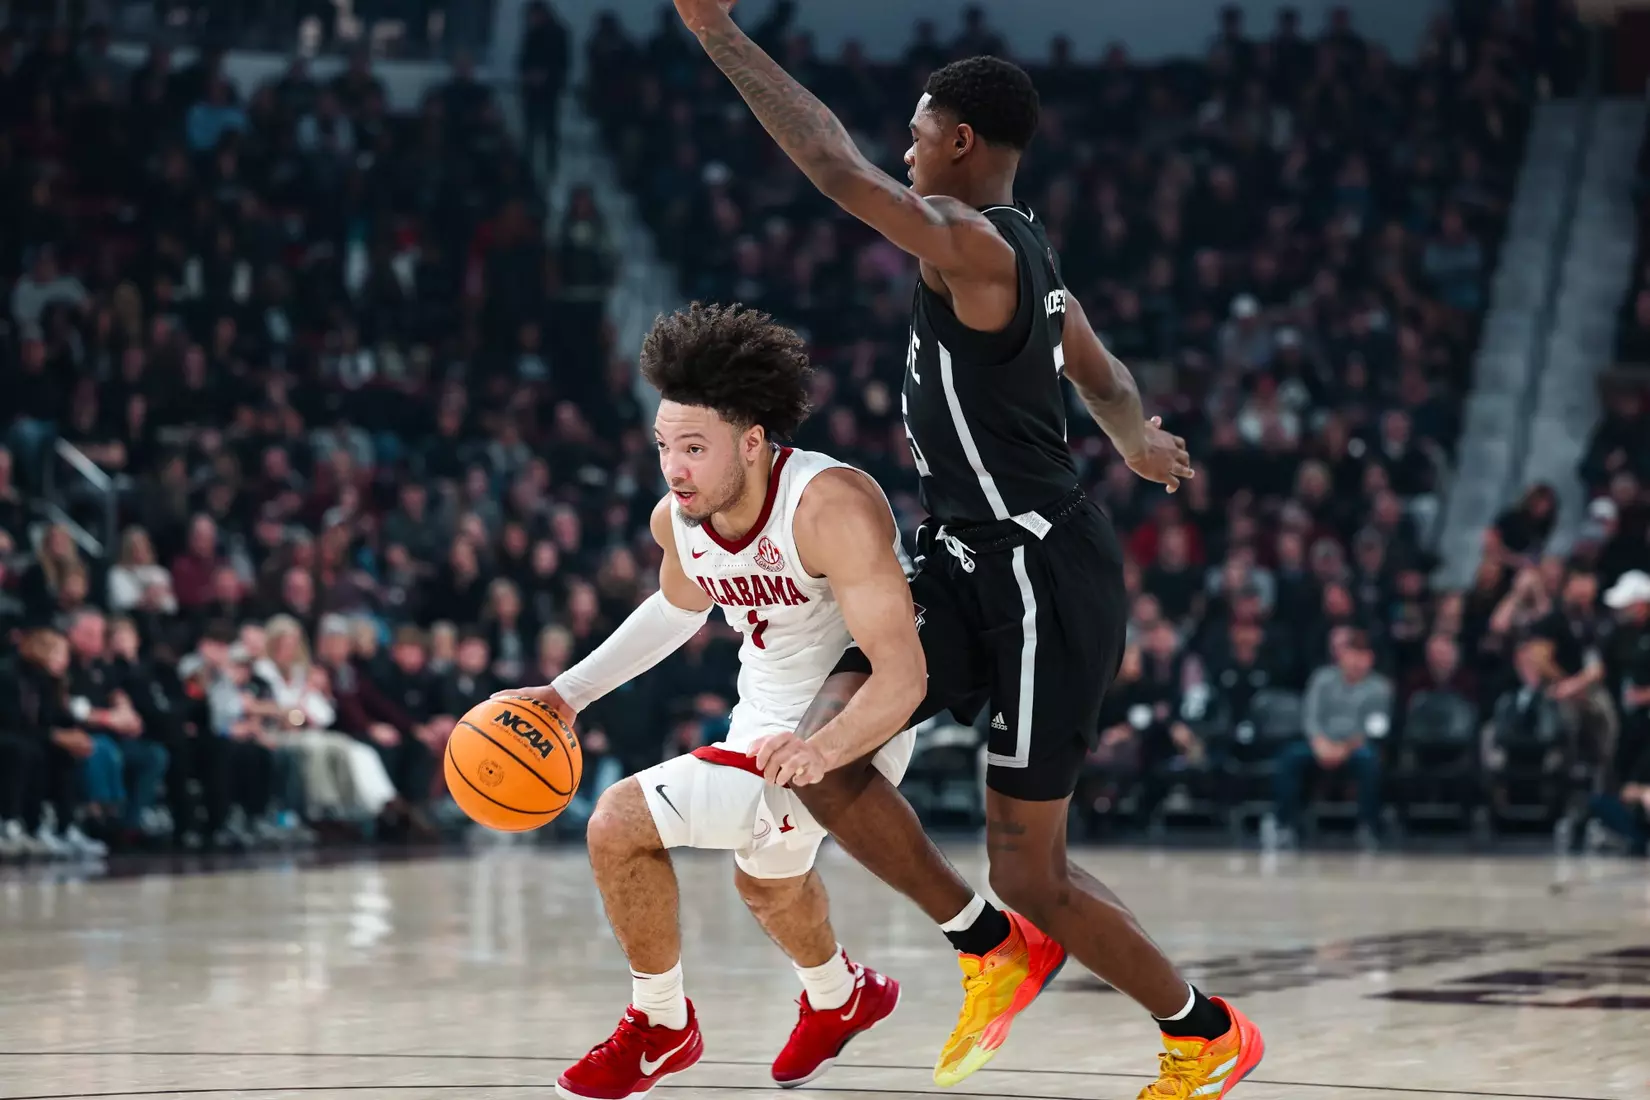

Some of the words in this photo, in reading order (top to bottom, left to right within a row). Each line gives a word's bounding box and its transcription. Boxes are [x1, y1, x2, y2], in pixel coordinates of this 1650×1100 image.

[696, 575, 810, 607] ALABAMA
[747, 609, 769, 650] 1
[494, 710, 555, 759] NCAA
